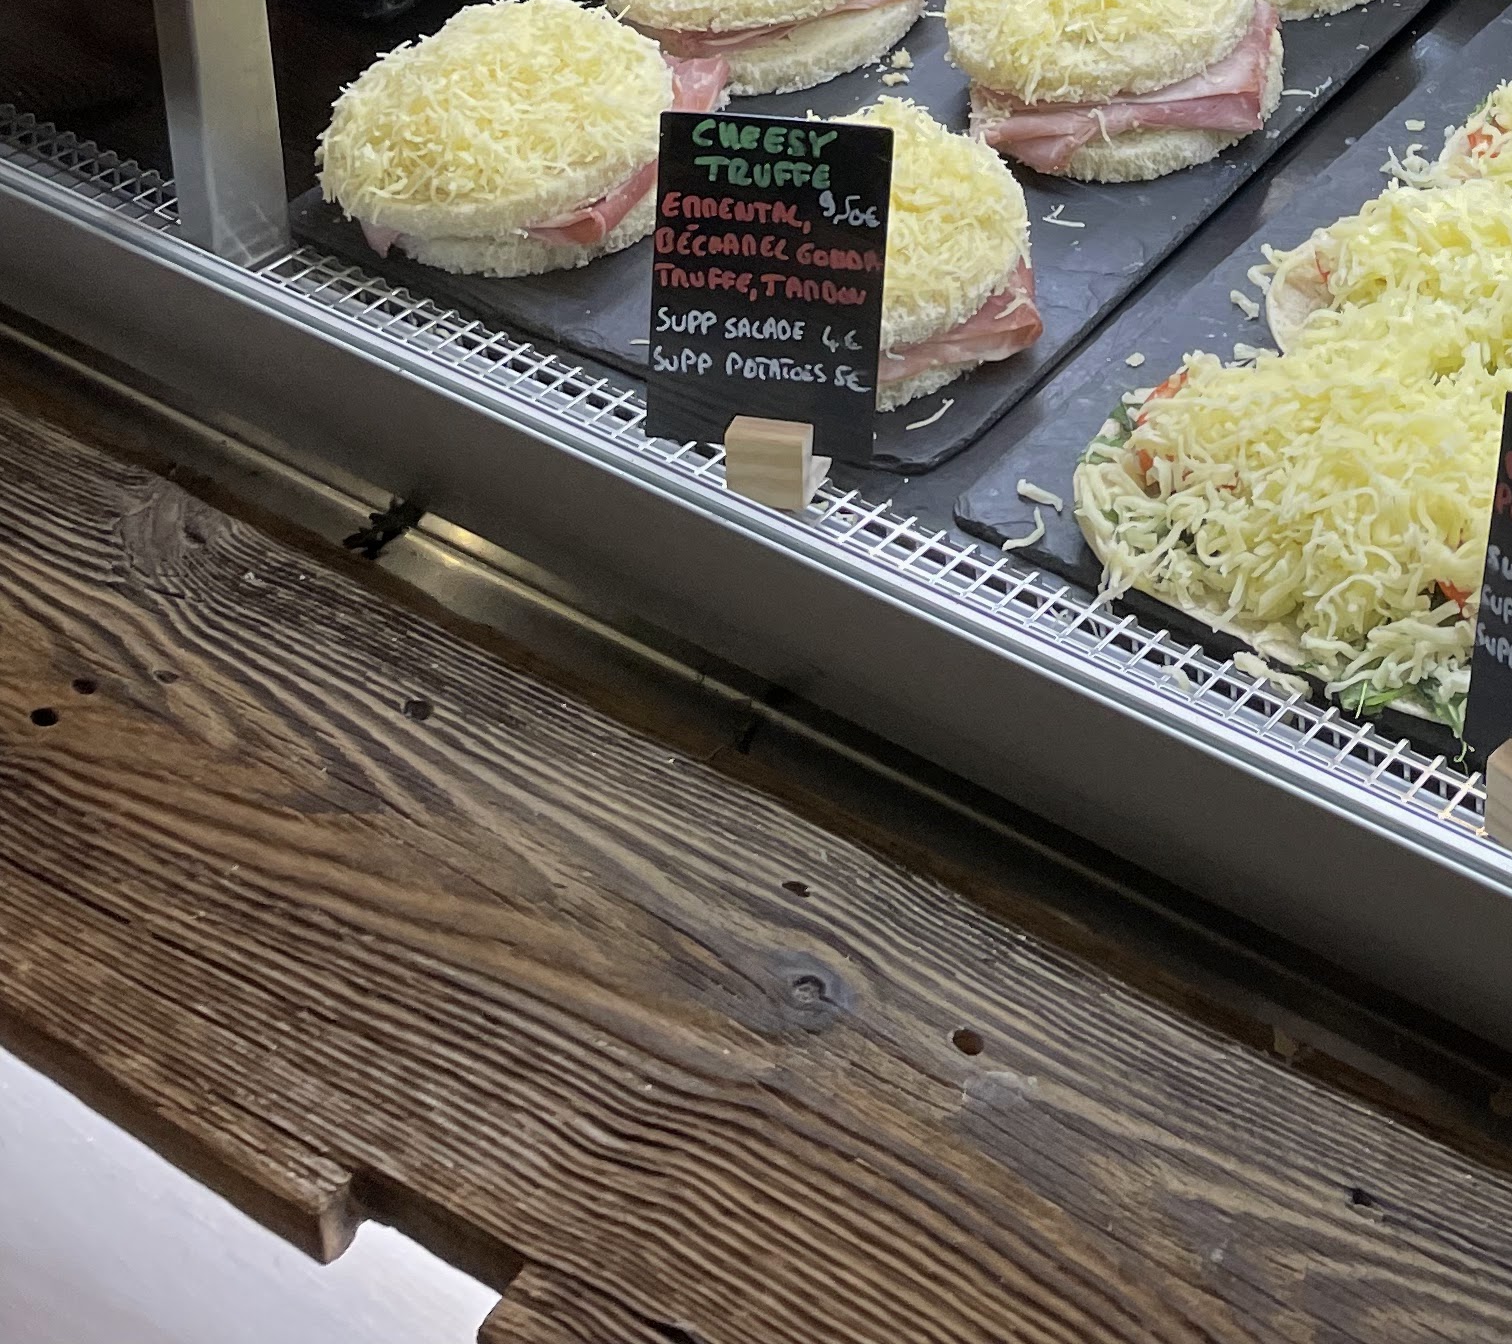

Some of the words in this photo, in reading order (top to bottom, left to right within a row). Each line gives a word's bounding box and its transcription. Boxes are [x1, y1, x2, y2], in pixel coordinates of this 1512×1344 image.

[692, 118, 838, 159] CHEESY
[694, 155, 831, 190] TRUFFE
[655, 306, 718, 336] SUPP
[724, 316, 806, 341] SALADE
[652, 345, 713, 376] SUPP
